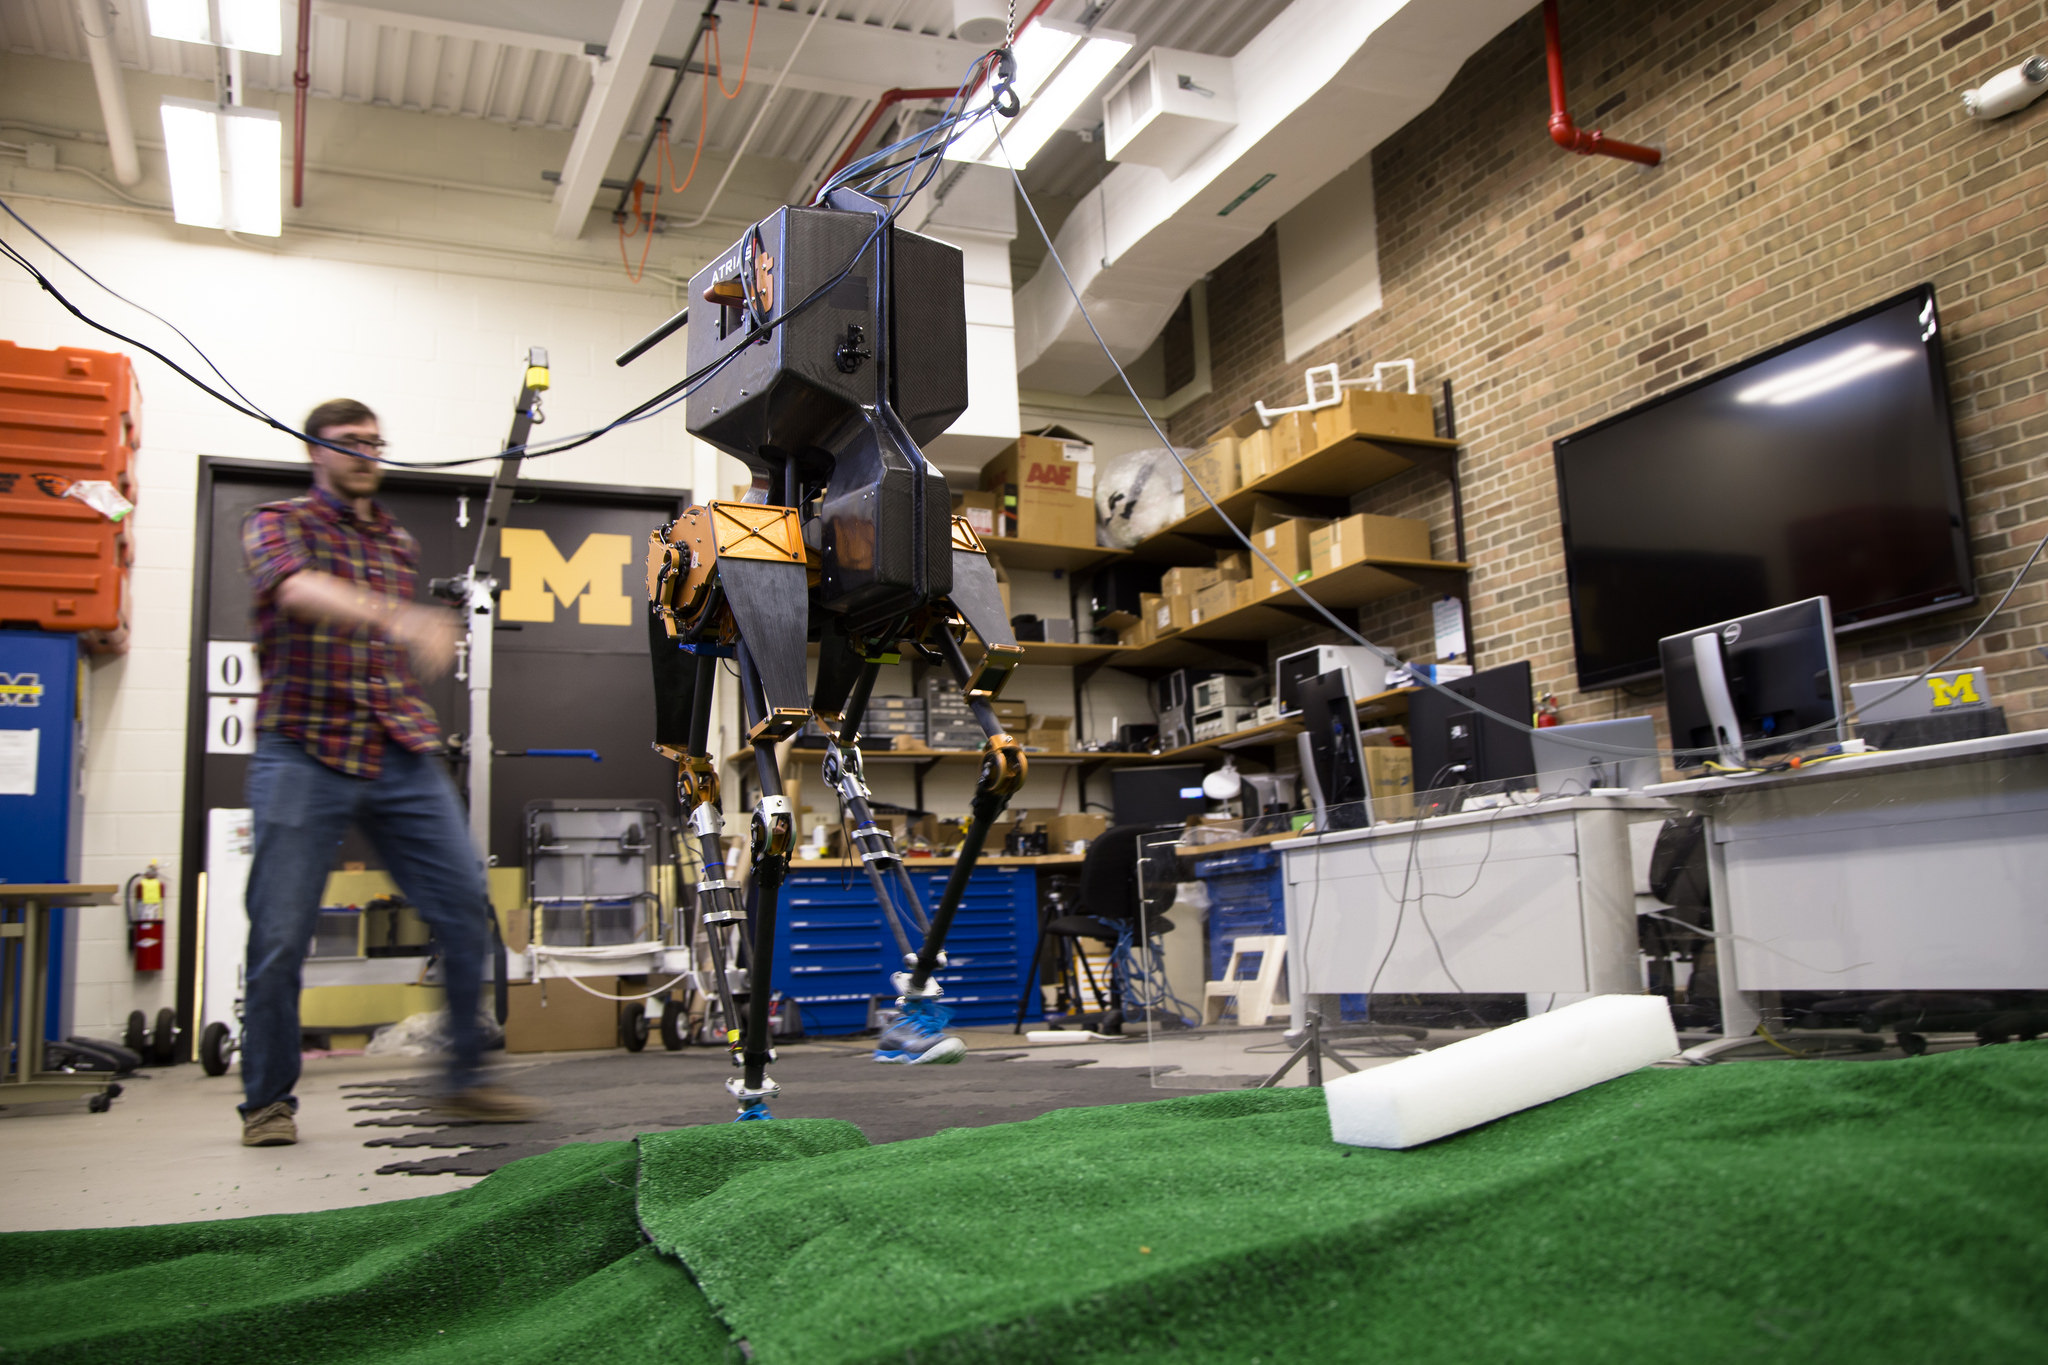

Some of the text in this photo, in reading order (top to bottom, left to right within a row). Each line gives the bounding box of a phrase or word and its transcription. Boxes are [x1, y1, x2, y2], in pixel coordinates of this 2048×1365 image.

[711, 244, 752, 286] ATRIS
[1027, 462, 1072, 486] AAF
[500, 527, 632, 626] M
[1927, 673, 1980, 707] M
